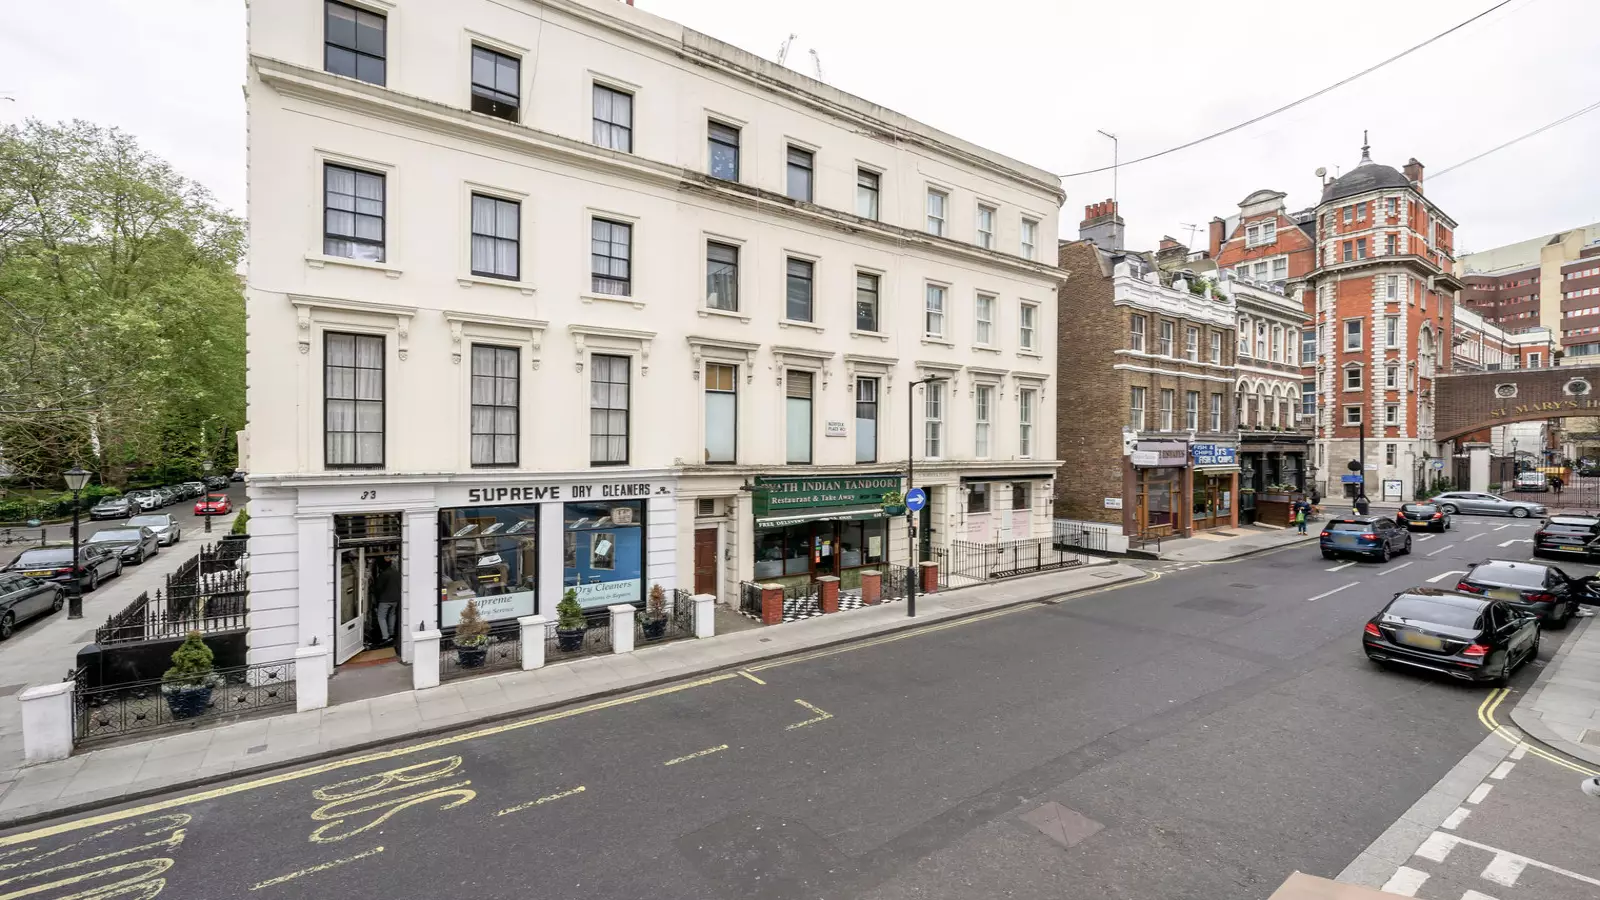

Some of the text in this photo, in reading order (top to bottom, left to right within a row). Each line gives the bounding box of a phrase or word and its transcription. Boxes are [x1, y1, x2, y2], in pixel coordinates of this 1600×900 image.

[1515, 400, 1578, 415] MARY'S
[802, 480, 841, 492] INDIAN
[844, 478, 897, 490] TANDOORI
[468, 486, 560, 502] SUPREME
[572, 485, 592, 498] DRY
[602, 483, 651, 497] CLEANERS
[771, 496, 811, 505] Restaurant
[822, 494, 837, 502] Take
[838, 494, 855, 502] Away
[595, 581, 632, 591] Cleaners
[474, 595, 513, 608] upreme
[309, 755, 477, 845] BUS
